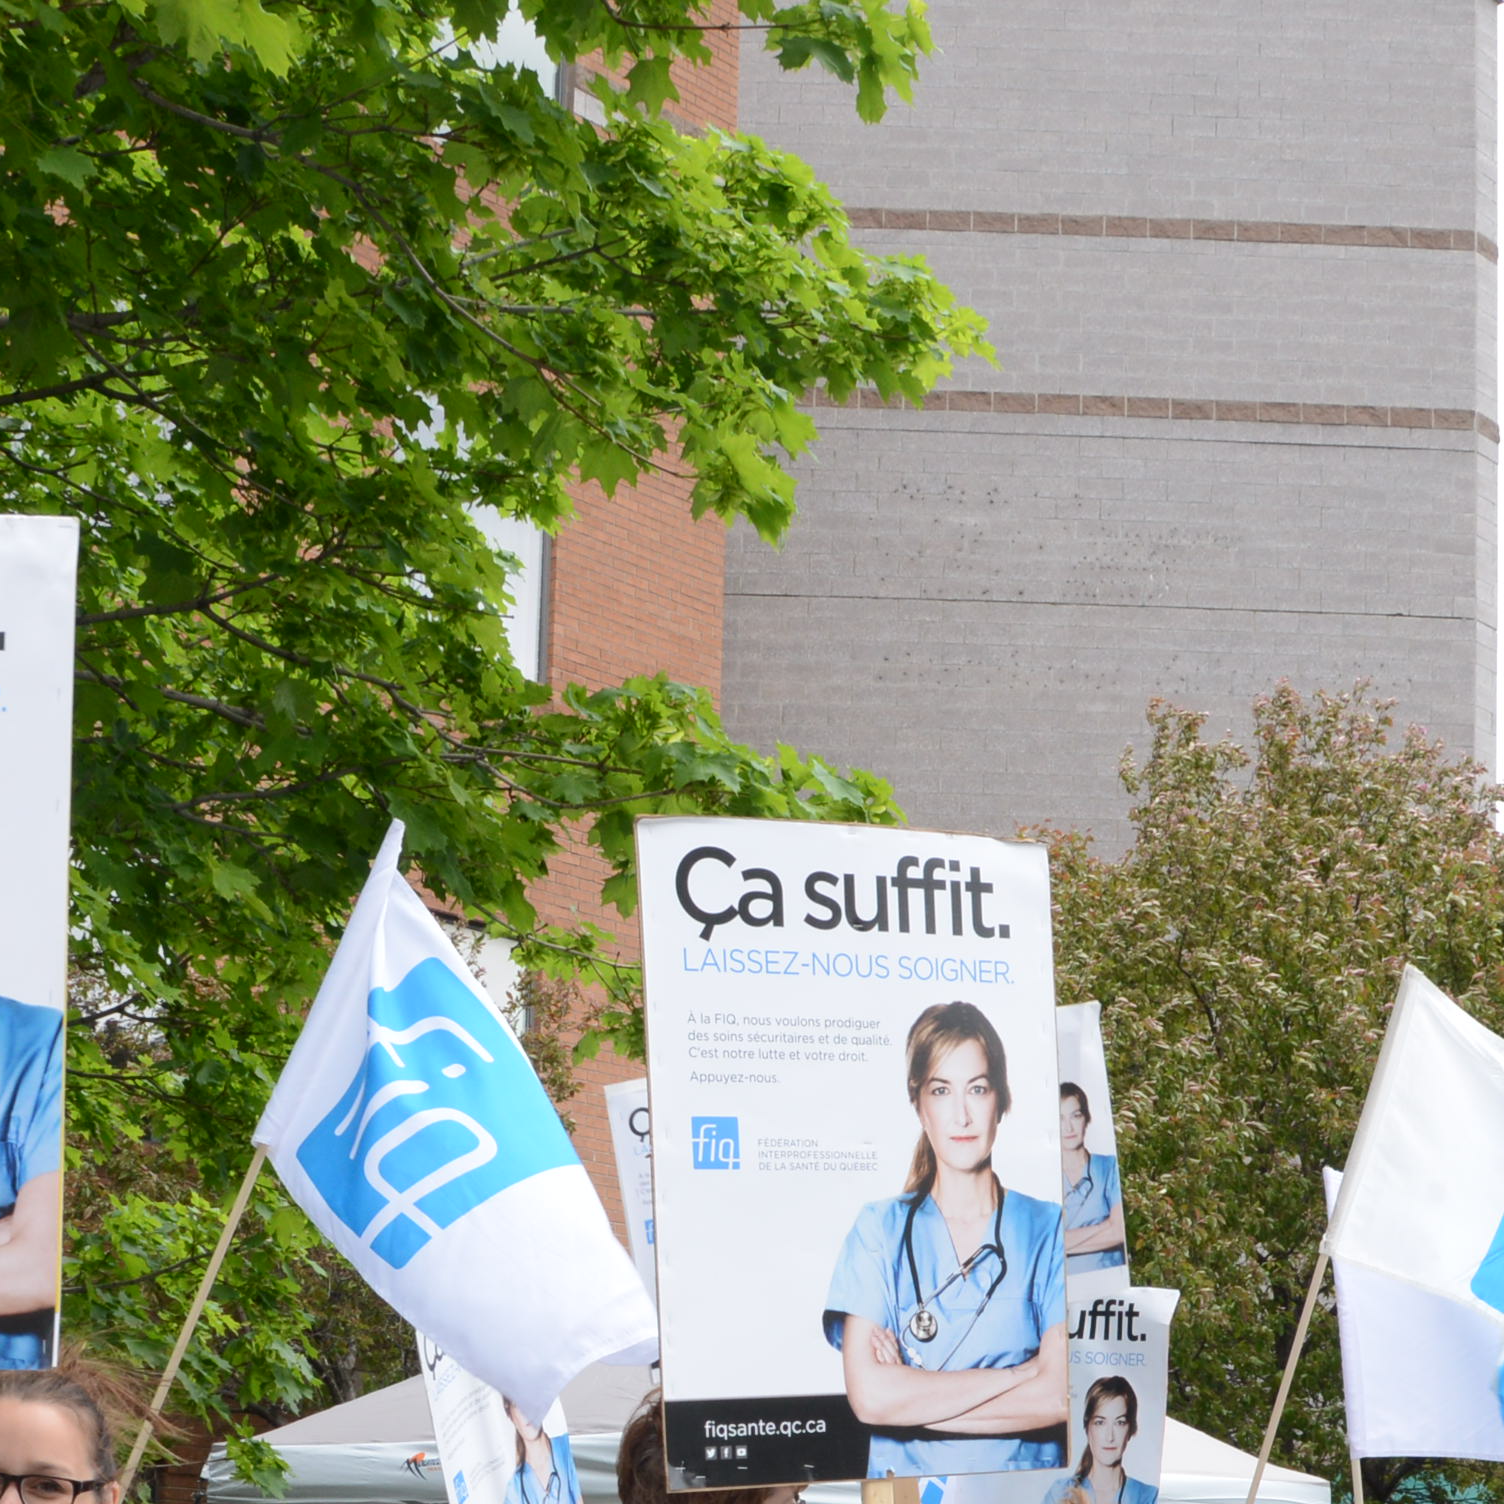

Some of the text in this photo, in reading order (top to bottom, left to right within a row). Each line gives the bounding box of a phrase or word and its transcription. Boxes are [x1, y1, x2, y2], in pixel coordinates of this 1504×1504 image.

[675, 846, 1012, 942] Ça suffit.
[682, 948, 1014, 985] LAISSEZ-NOUS SOIGNER.
[687, 1010, 880, 1031] À la FIQ, nous voulons prodiguer
[688, 1031, 893, 1048] des soins sécuritaires et de qualité.
[688, 1047, 868, 1062] C'est notre lutte et votre droit.
[689, 1070, 781, 1086] Appuyez-nous.
[692, 1123, 741, 1169] fiq
[757, 1136, 818, 1148] FÉDÉRATION
[757, 1150, 878, 1160] INTERPROFESSIONNELLE
[759, 1160, 879, 1172] DE LA SANTÉ DU QUÉBEC
[1069, 1299, 1146, 1342] uffit.
[1085, 1352, 1145, 1367] SOIGNER.
[704, 1419, 826, 1440] fiqsante.qc.ca
